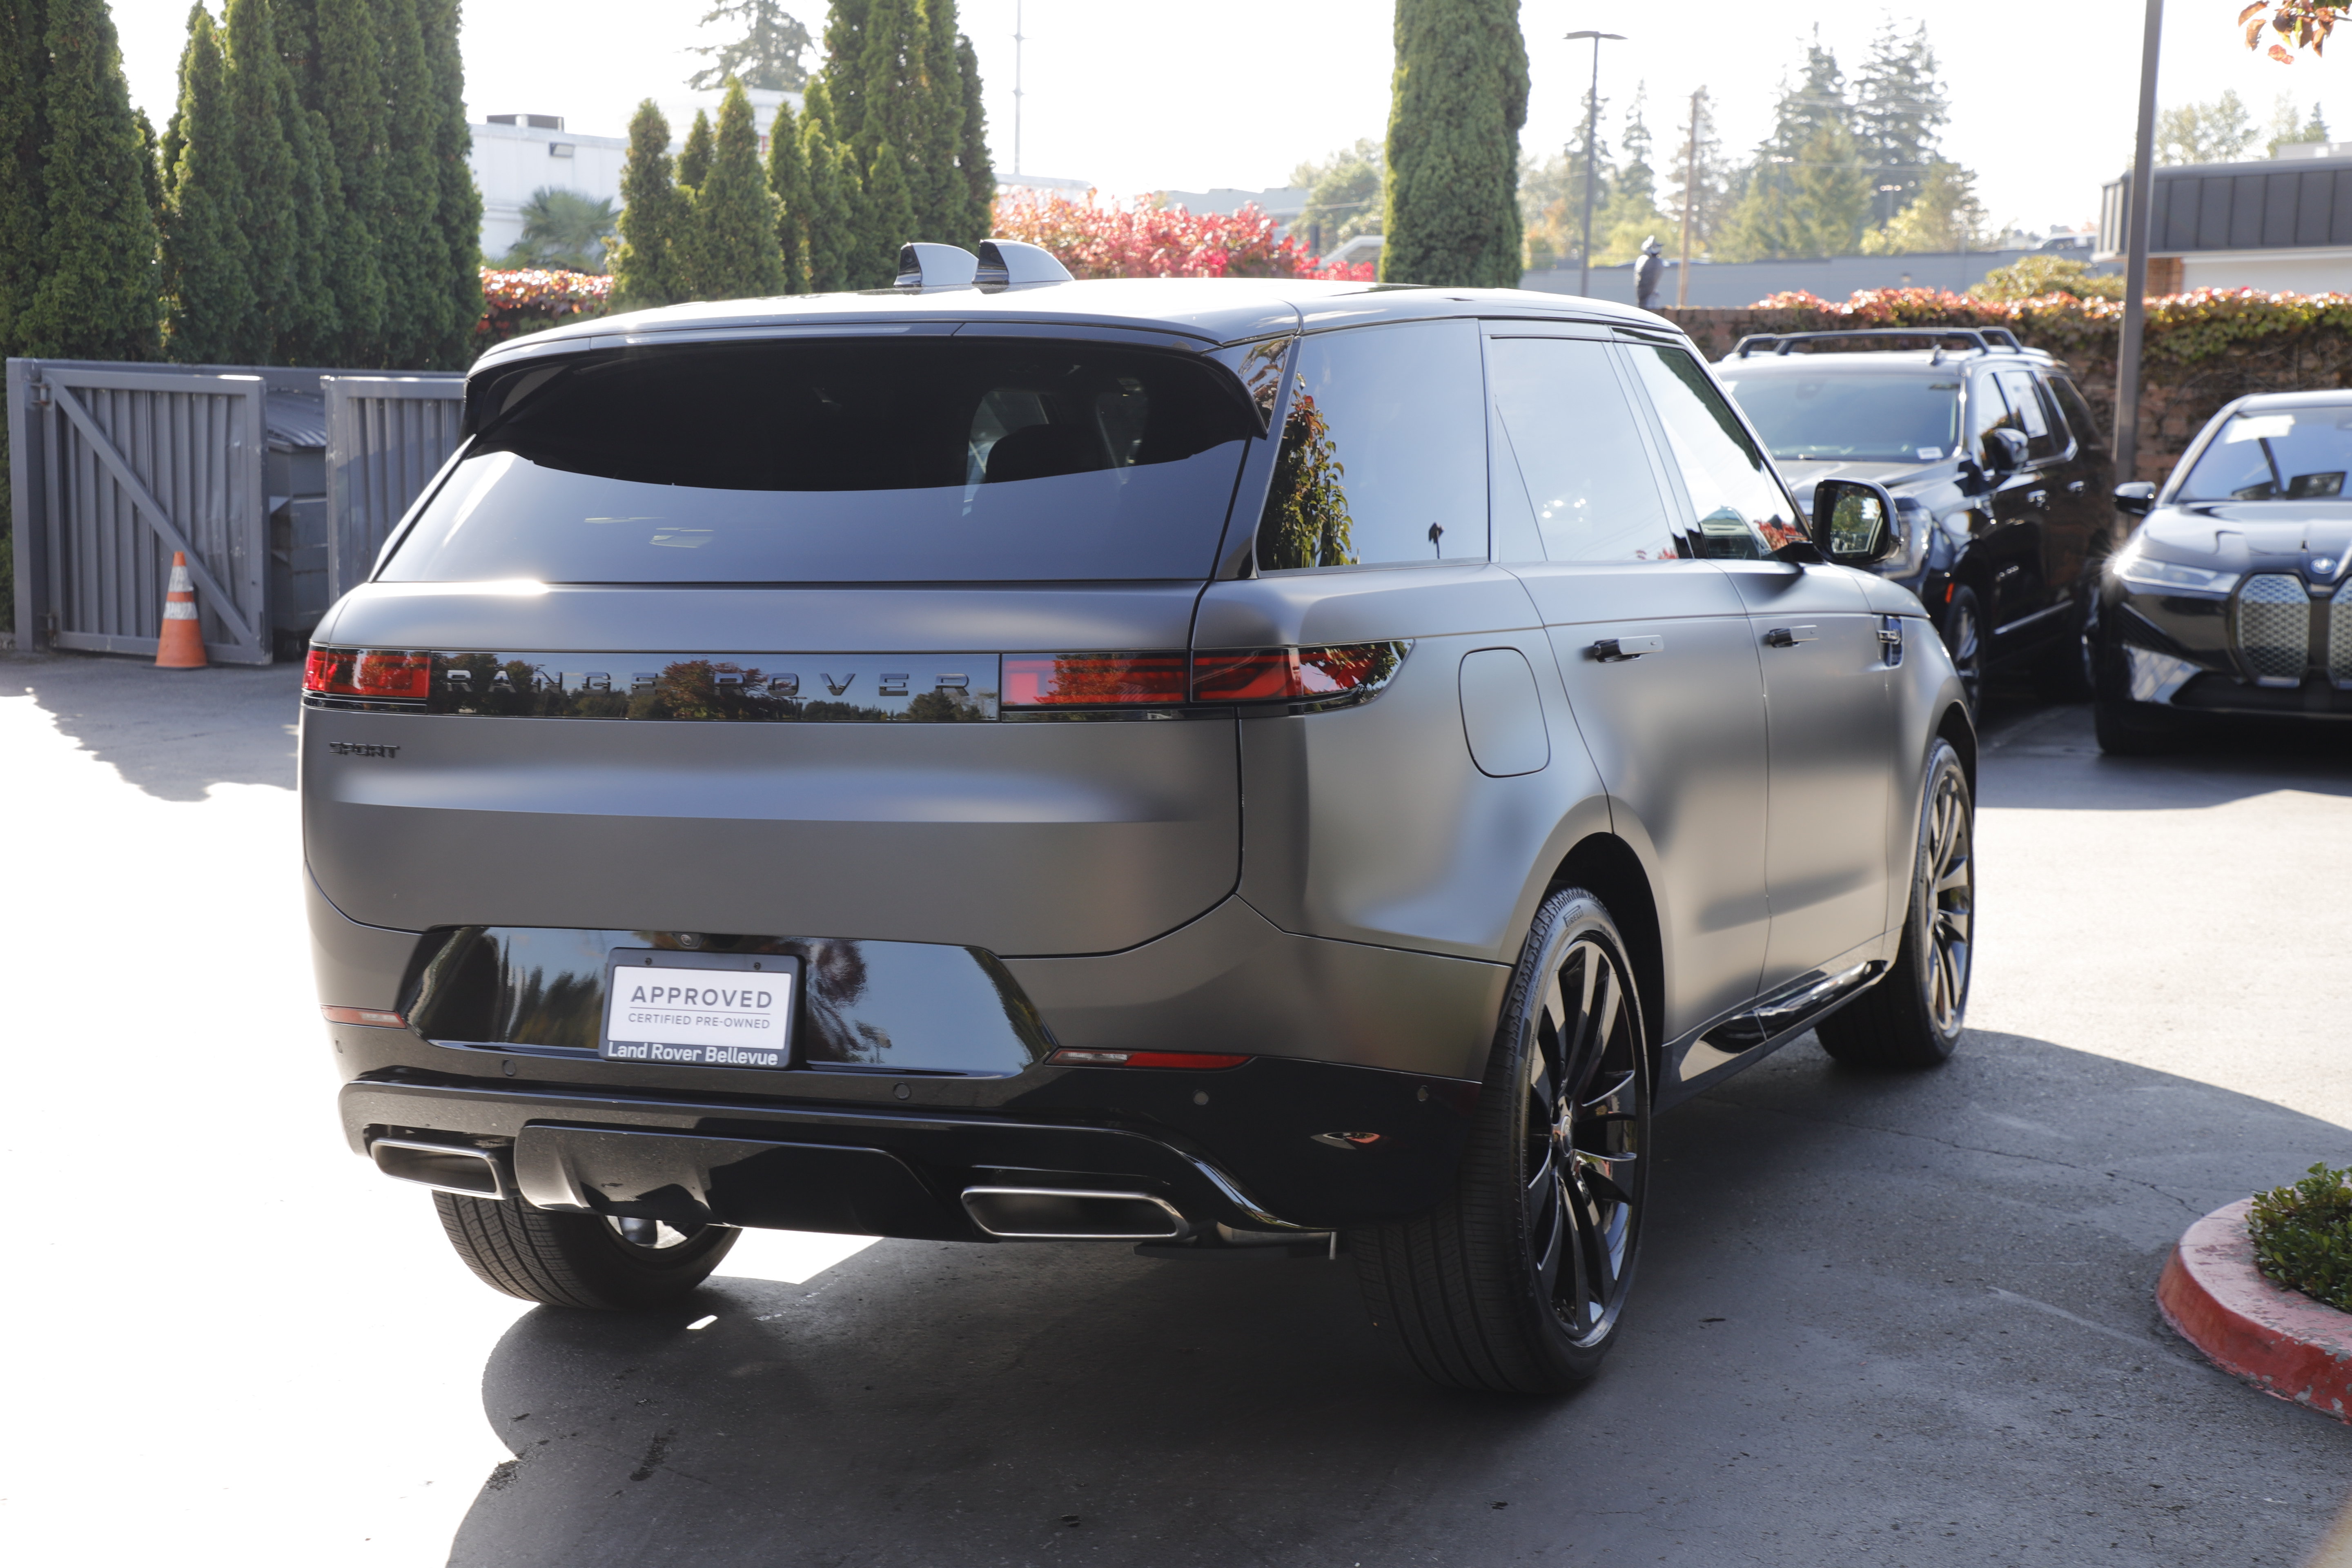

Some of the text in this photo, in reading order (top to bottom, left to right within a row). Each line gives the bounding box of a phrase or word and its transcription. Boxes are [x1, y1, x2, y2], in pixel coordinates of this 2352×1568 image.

[446, 669, 970, 697] RANGE ROVER
[329, 741, 400, 759] SPORT
[1562, 904, 1584, 928] PIRELLI
[630, 985, 773, 1009] APPROVED
[628, 1013, 771, 1029] CERTIFIED PRE-OWNED
[607, 1041, 779, 1066] Land Rover Bellevue
